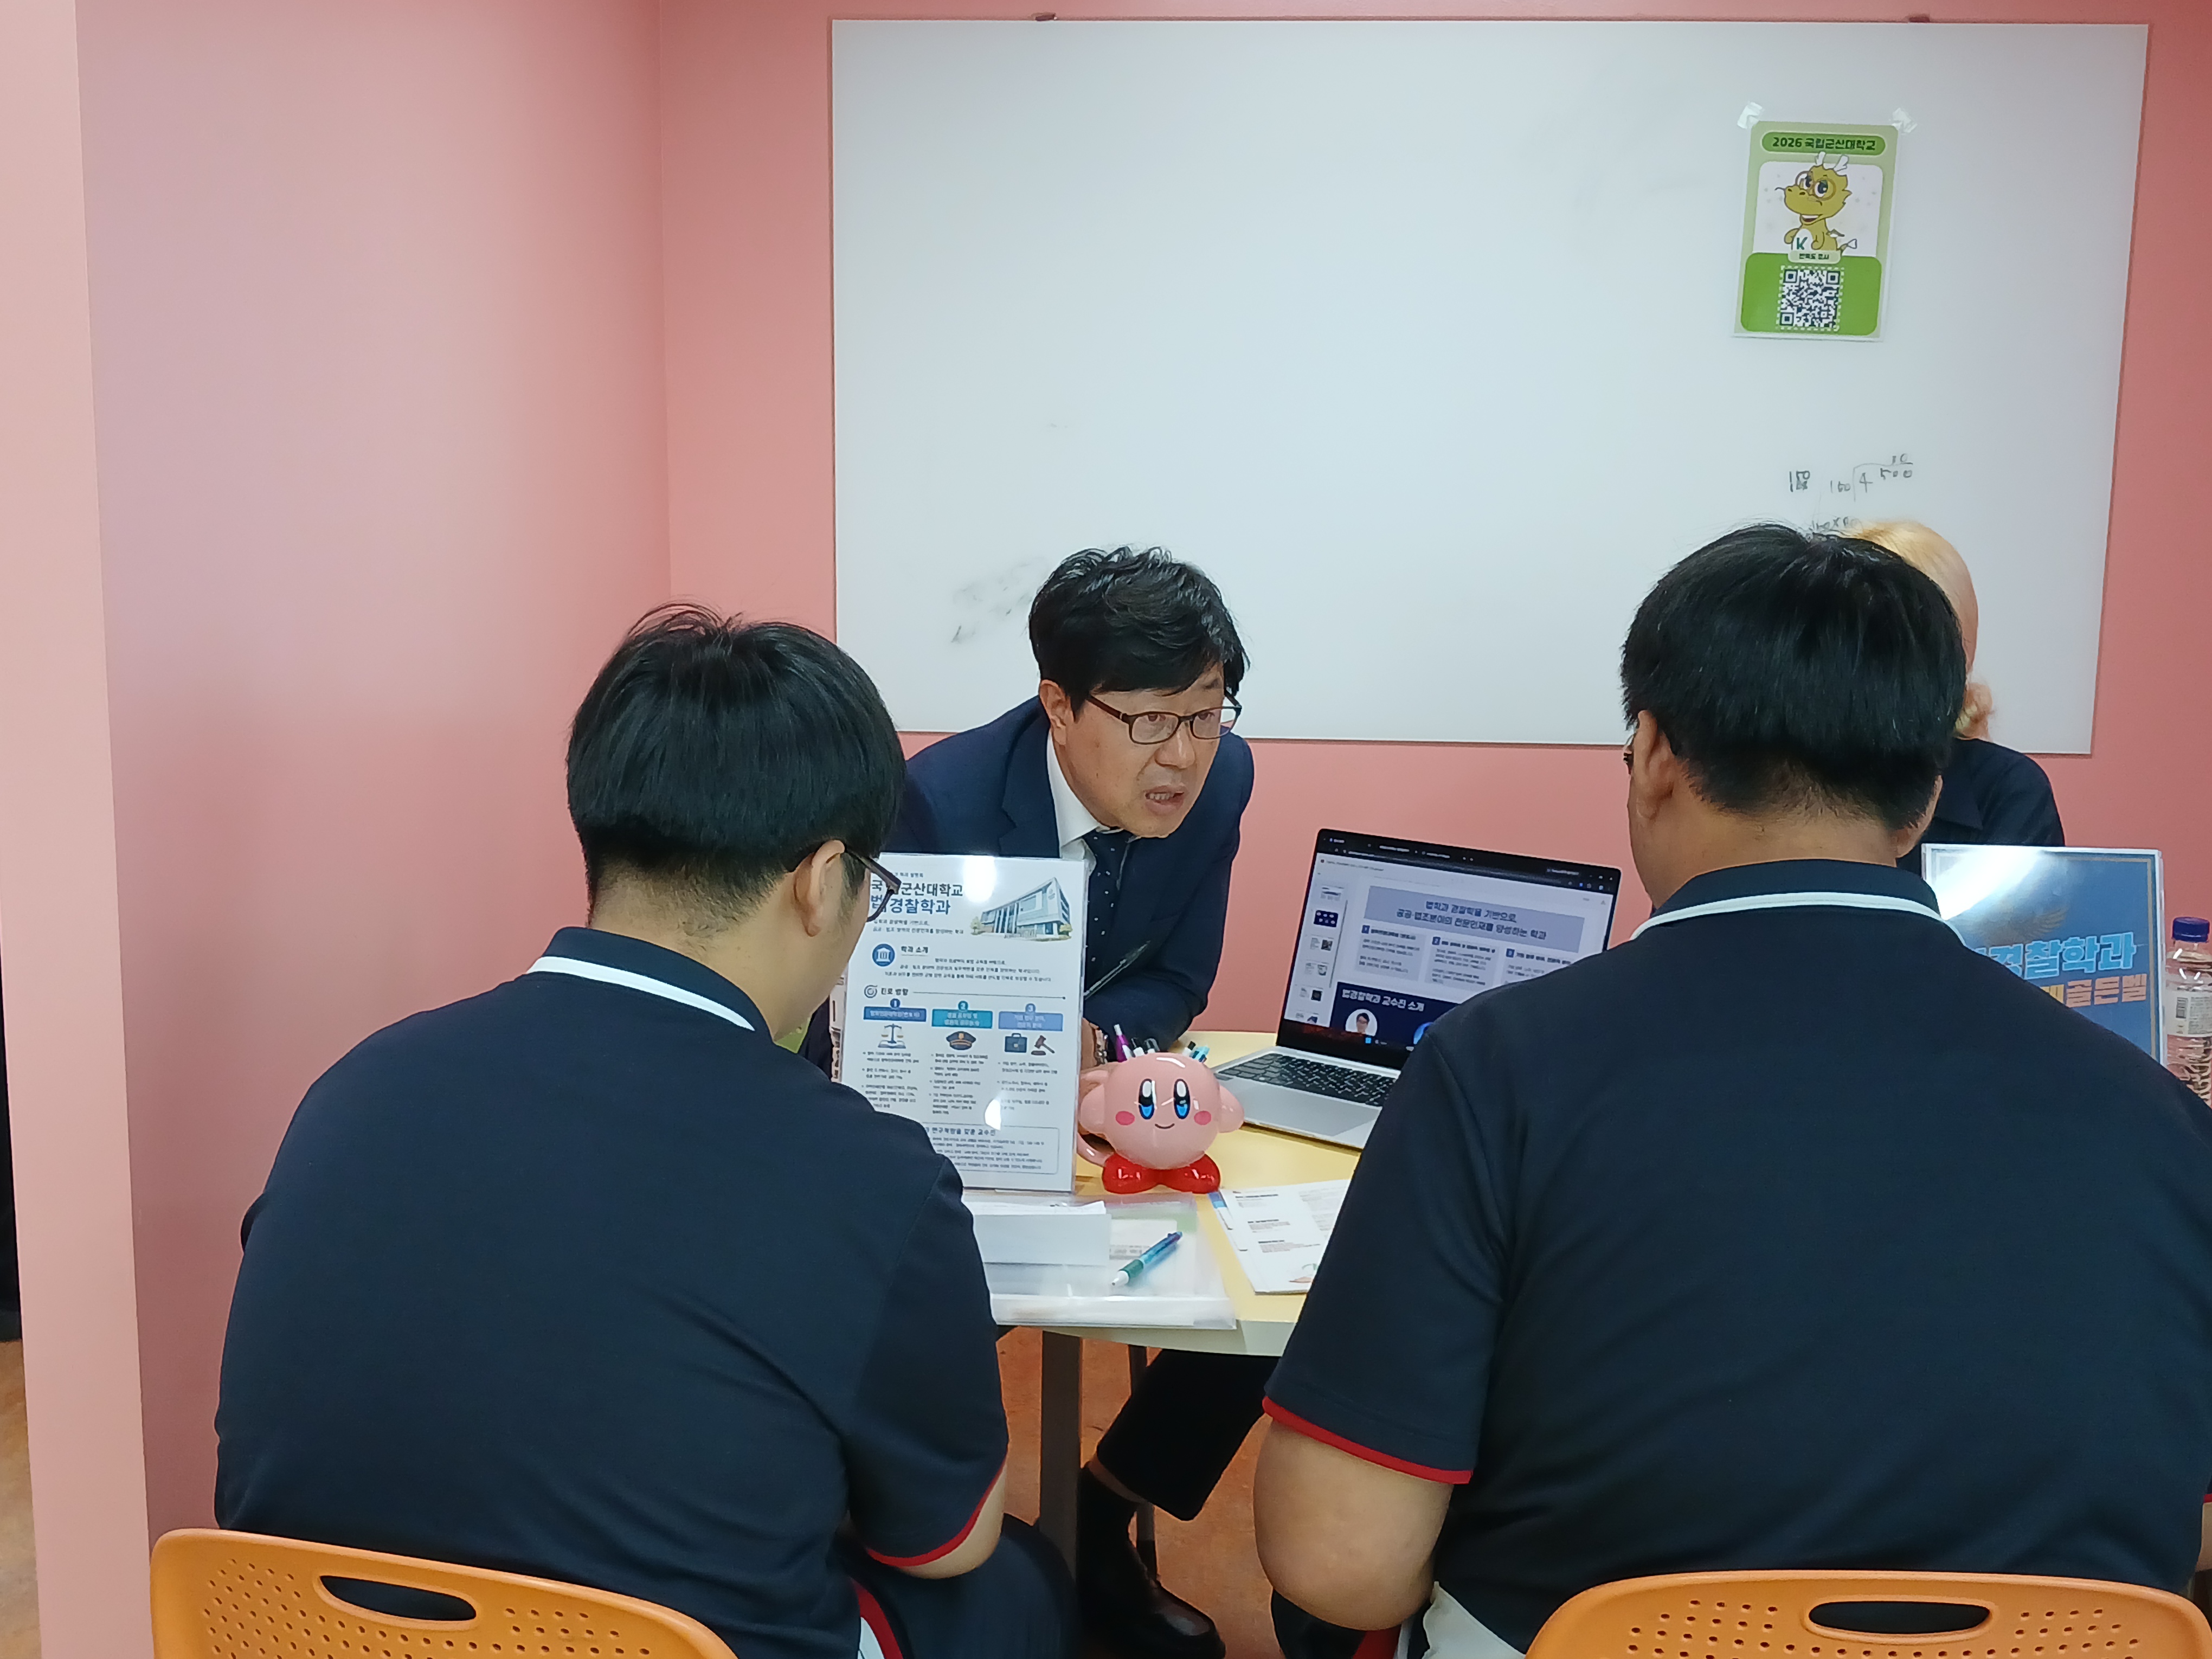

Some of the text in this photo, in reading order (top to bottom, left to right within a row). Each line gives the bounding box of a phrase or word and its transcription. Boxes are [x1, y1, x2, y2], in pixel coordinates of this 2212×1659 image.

[1772, 137, 1876, 151] 2026 국립군산대학교
[1796, 236, 1808, 250] K
[871, 879, 963, 897] 국군산대학교
[1976, 931, 2137, 980] 경찰학과
